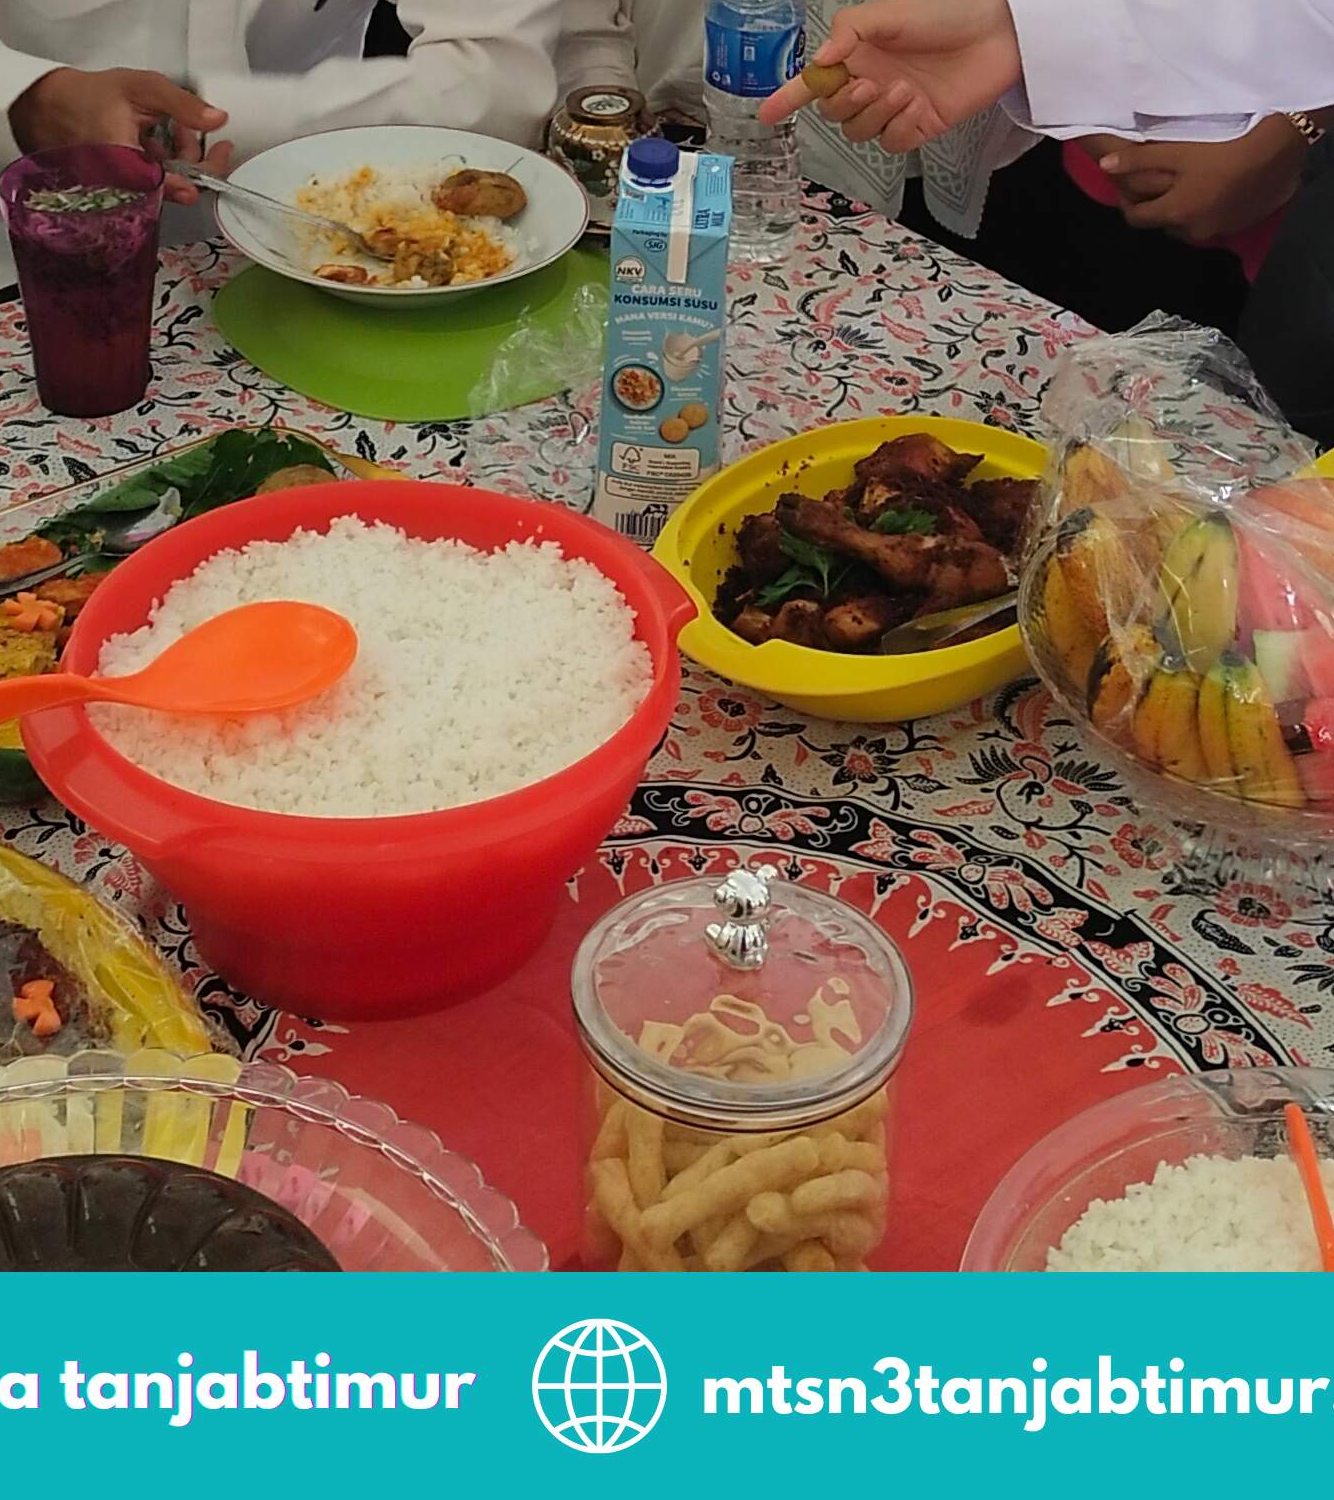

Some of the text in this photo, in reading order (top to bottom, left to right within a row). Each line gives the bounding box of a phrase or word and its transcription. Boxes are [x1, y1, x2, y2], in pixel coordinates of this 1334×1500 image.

[617, 267, 643, 276] NKV
[631, 284, 702, 298] CARA SERU
[614, 294, 718, 311] KONSUMSI SUSU
[646, 311, 677, 321] VERSI
